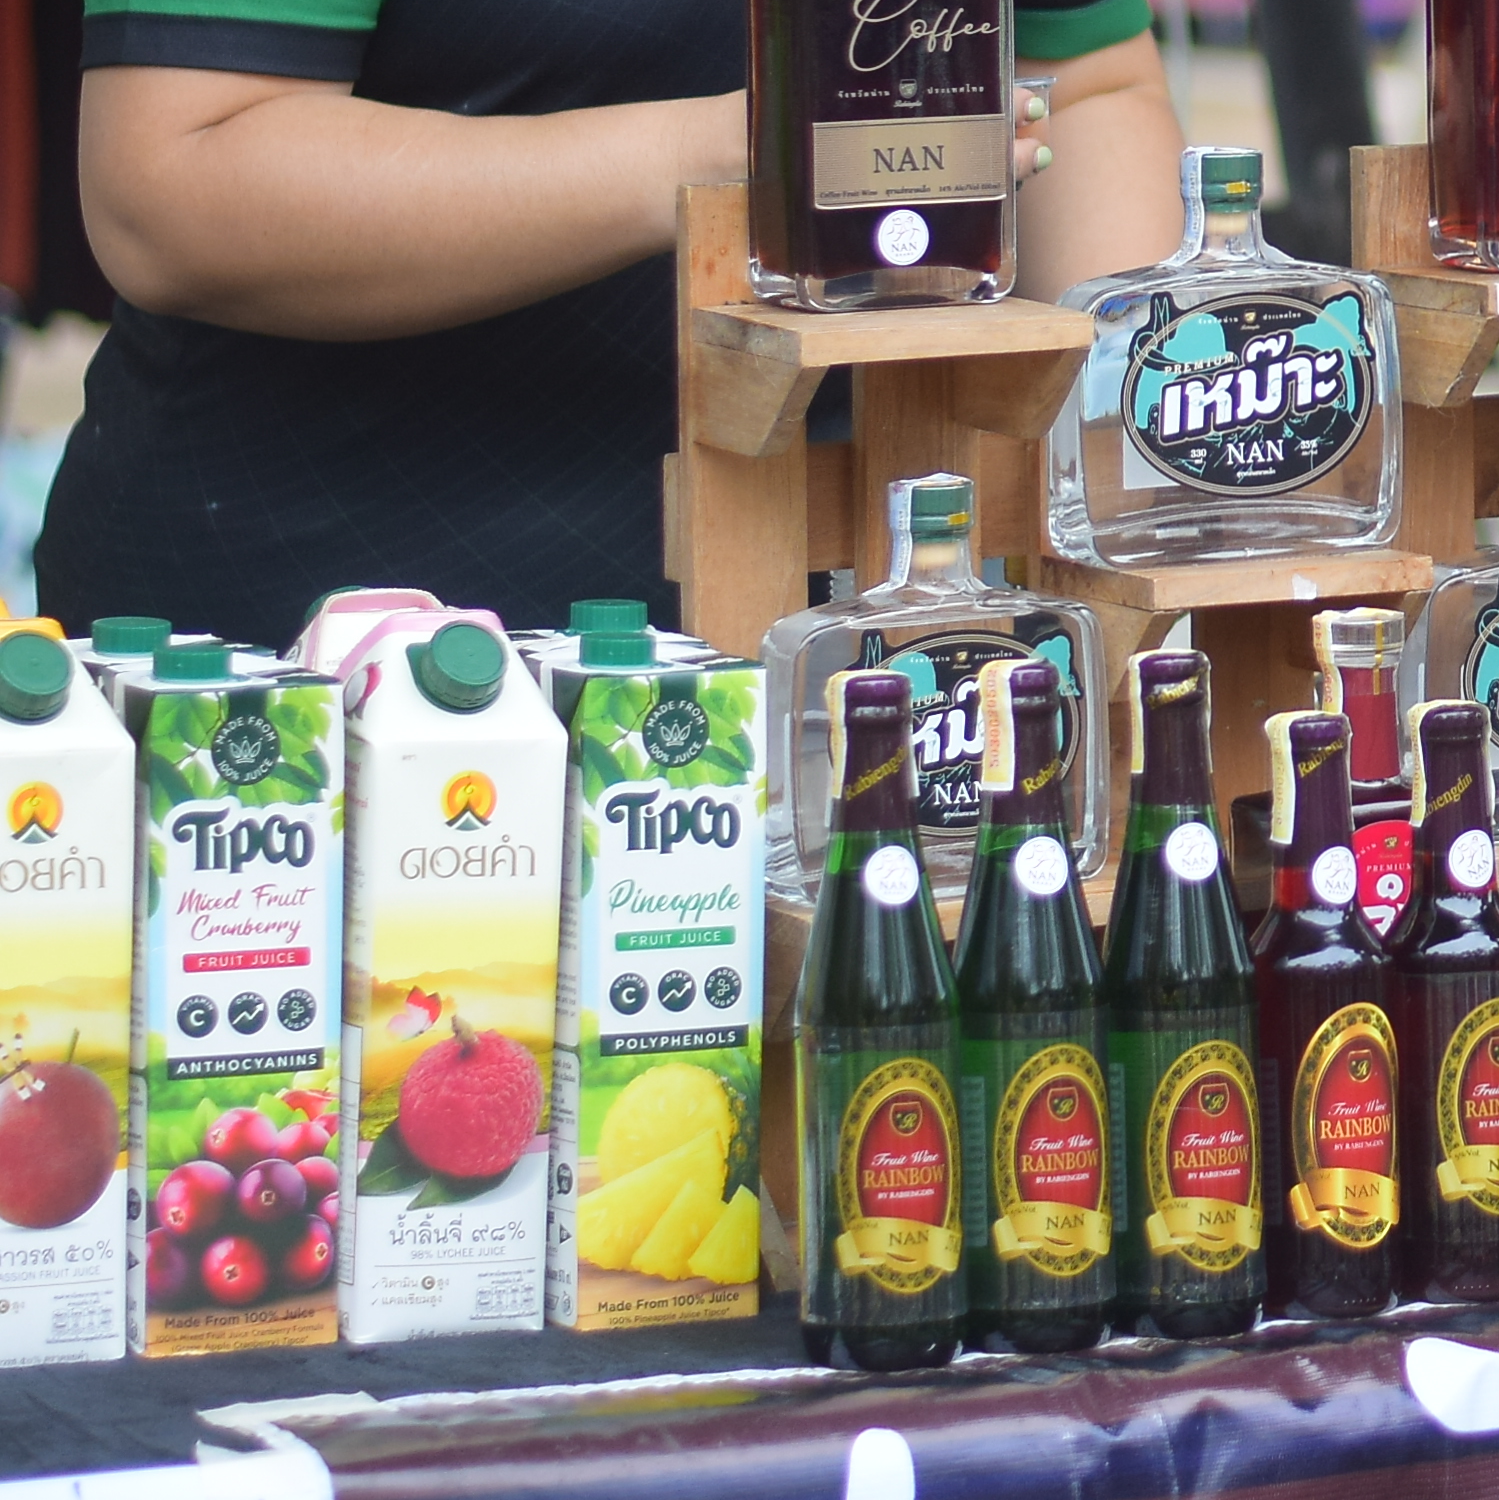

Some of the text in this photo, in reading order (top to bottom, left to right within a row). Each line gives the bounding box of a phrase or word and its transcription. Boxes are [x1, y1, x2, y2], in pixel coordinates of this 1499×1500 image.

[873, 145, 944, 173] NAN
[891, 242, 918, 253] NAN
[1164, 354, 1234, 375] PREMIUM
[1190, 449, 1207, 458] 330
[1227, 440, 1285, 465] NAN
[647, 700, 706, 727] MADE FROM
[216, 716, 277, 744] MADE FROM
[673, 740, 702, 764] JUICE
[218, 760, 240, 781] 100%
[605, 788, 741, 855] Tipco
[172, 807, 315, 874] Tipco
[400, 834, 537, 879] ดอยคำ
[1182, 856, 1209, 867] NAN
[1028, 870, 1057, 881] NAN
[1325, 879, 1350, 890] NAN
[177, 884, 315, 915] Mixed Fruit
[609, 879, 742, 923] Pineapple
[191, 915, 301, 943] Cranberry
[630, 931, 721, 946] FRUIT JUICE
[199, 952, 295, 968] FRUIT JUICE
[622, 988, 636, 1003] C
[190, 1010, 204, 1026] C
[615, 1031, 736, 1050] POLYPHENOLS
[176, 1053, 318, 1074] ANTHOCYANINS
[1328, 1099, 1387, 1116] Fruit Wine
[1320, 1114, 1391, 1139] RAINBOW
[1029, 1134, 1093, 1151] Fruit Wine
[1182, 1130, 1244, 1147] Fruit Wine
[871, 1150, 939, 1167] Fruit Wine
[1022, 1148, 1099, 1173] RAINBOW
[1174, 1144, 1249, 1169] RAINBOW
[863, 1163, 944, 1189] RAINBOW
[1345, 1182, 1379, 1199] NAN
[1046, 1214, 1084, 1230] NAN
[1199, 1209, 1236, 1226] NAN
[389, 1213, 525, 1245] น้ำลิ้นจี่ ๙๘%
[889, 1230, 929, 1246] NAN
[65, 1239, 113, 1262] ๕๐%
[410, 1246, 506, 1260] 98% LYCHEE JUICE
[40, 1265, 100, 1279] FRUIT JUICE
[598, 1291, 739, 1313] Made From 100% Juice
[165, 1308, 315, 1329] Made From 100% Juice
[679, 1310, 701, 1320] Juice
